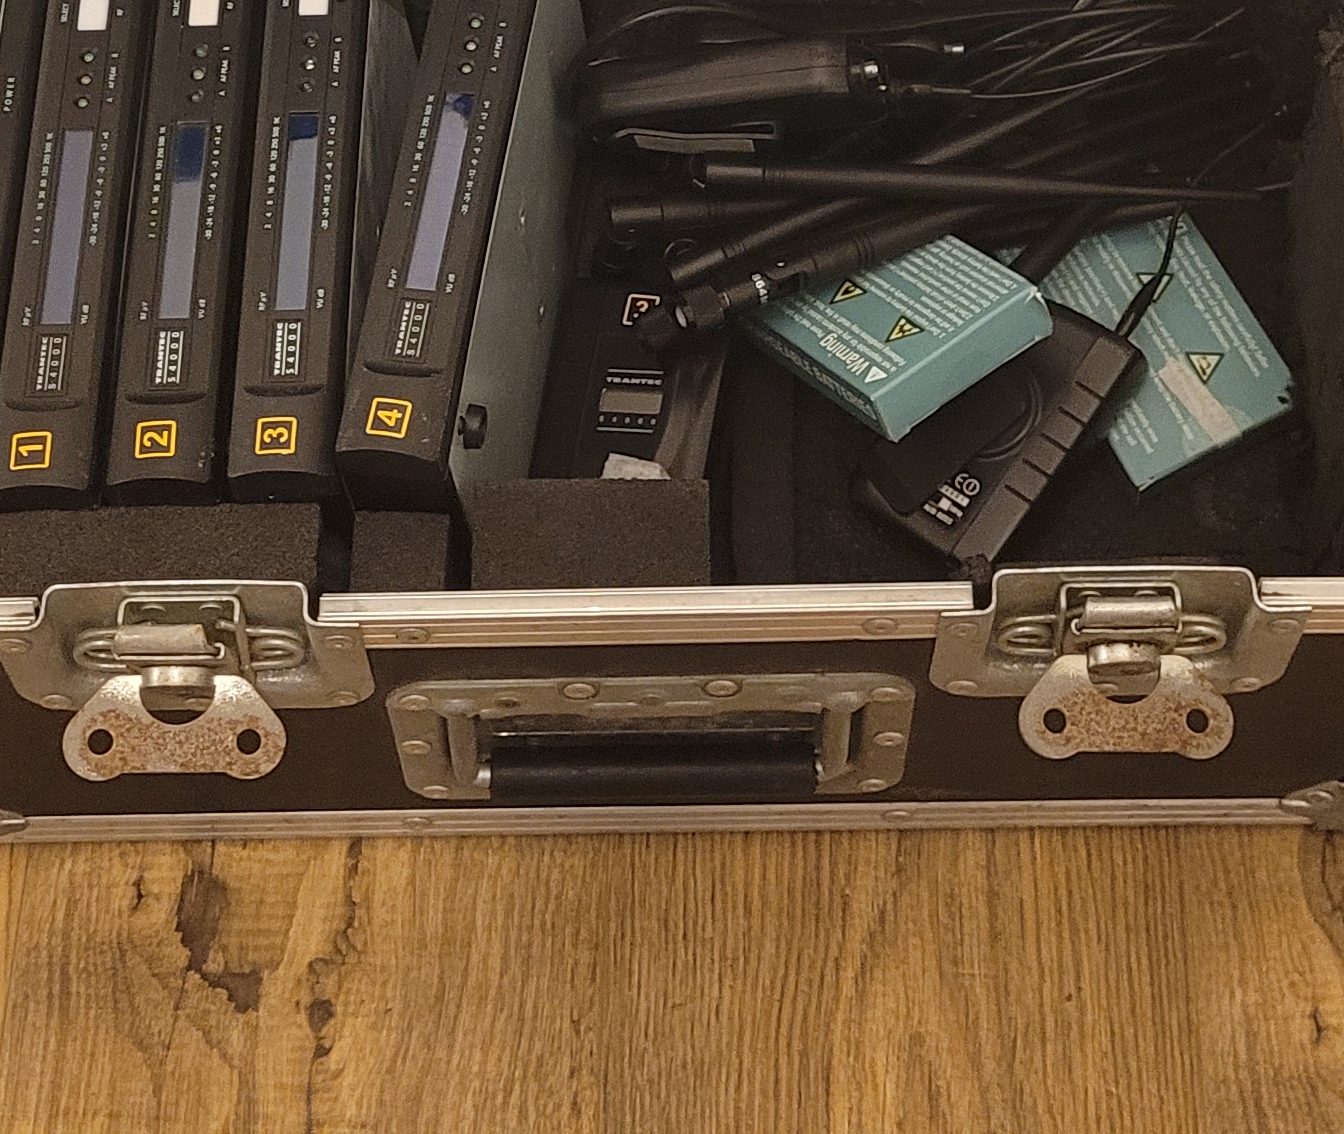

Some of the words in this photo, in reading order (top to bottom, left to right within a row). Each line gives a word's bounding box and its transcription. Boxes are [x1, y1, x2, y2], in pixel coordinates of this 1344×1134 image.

[2, 77, 15, 111] POWER
[273, 322, 283, 375] TRANTEC
[285, 322, 297, 374] S4000
[394, 301, 411, 354] TRANTEC
[406, 302, 424, 355] S4000
[35, 336, 48, 390] TRANTEC
[47, 337, 62, 389] S4000
[154, 331, 166, 383] TRANTEC
[166, 331, 179, 382] S4000
[819, 332, 870, 376] Warning
[606, 376, 662, 385] TRANTEC
[143, 431, 168, 447] 2
[263, 426, 289, 444] 3
[377, 409, 403, 427] 4
[18, 444, 44, 458] 1
